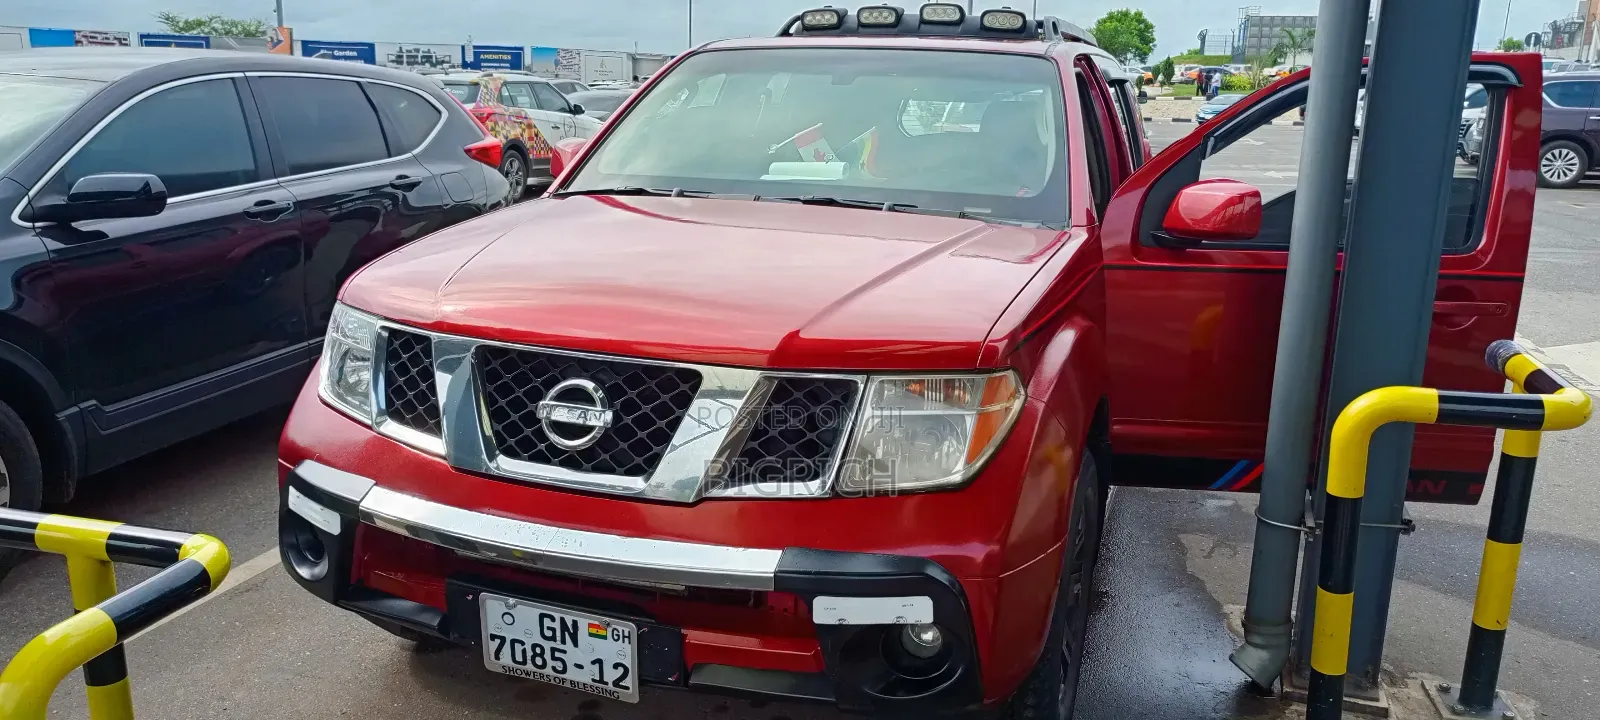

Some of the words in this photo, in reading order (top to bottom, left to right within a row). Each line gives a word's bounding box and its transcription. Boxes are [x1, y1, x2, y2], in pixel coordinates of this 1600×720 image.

[333, 49, 358, 57] Garden
[539, 402, 603, 423] NISSAN
[538, 612, 579, 648] GN
[611, 627, 631, 645] GH
[489, 633, 630, 691] 7085-12
[502, 665, 551, 683] SHOWERS
[553, 676, 567, 687] OF
[569, 680, 620, 700] BLESSING
